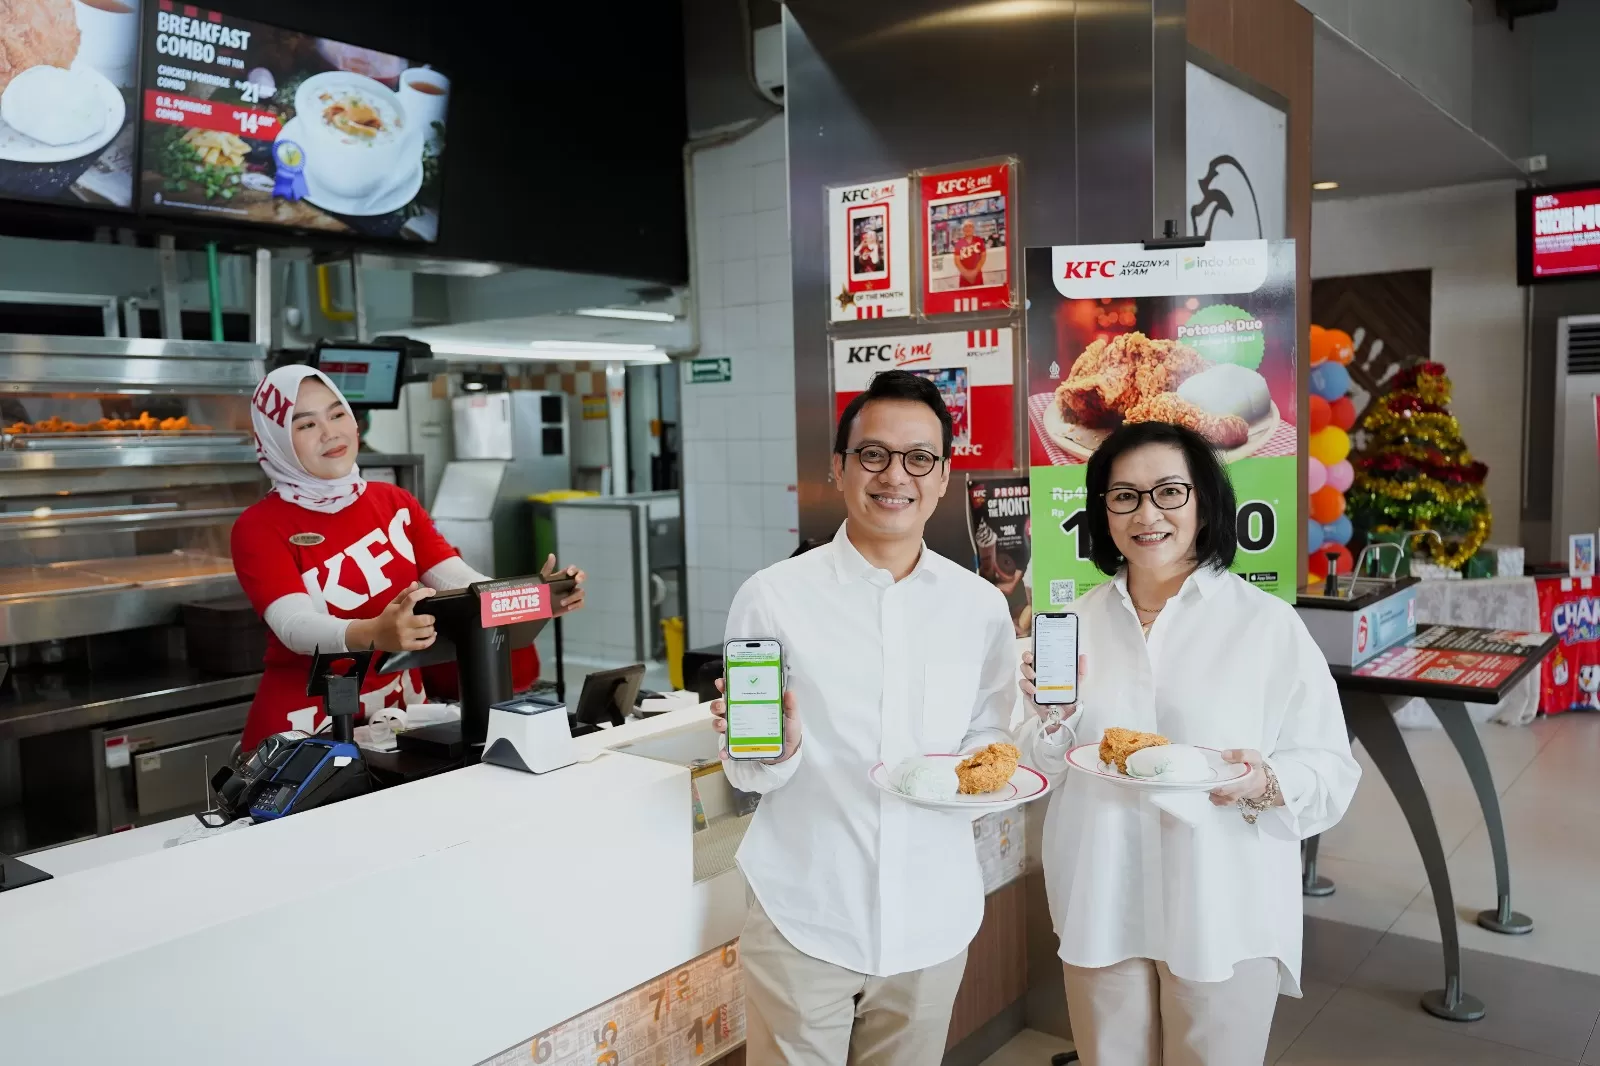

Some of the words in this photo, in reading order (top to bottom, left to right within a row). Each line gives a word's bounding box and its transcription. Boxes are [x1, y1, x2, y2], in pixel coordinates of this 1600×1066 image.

[157, 11, 251, 51] BREAKFAST
[156, 34, 216, 64] COMBO
[936, 178, 966, 194] KFC
[841, 188, 869, 203] KFC
[960, 242, 981, 260] KFC
[1064, 260, 1116, 279] KFC
[1122, 260, 1170, 268] JAGONYA
[1119, 268, 1149, 276] AYAM
[879, 291, 904, 299] MONTH
[1236, 319, 1263, 331] Duo
[847, 345, 892, 363] KFC
[894, 343, 905, 361] is
[252, 376, 295, 428] KF
[953, 444, 983, 456] KFC
[973, 489, 987, 498] KFC
[994, 486, 1028, 498] PROMO
[998, 497, 1030, 517] MONT
[1051, 508, 1065, 519] Rp
[301, 508, 416, 616] KFC
[491, 589, 521, 599] PESANAN
[521, 586, 540, 595] ANDA
[491, 594, 540, 613] GRATIS
[648, 988, 667, 1022] 7
[687, 1006, 722, 1056] 11
[531, 1033, 552, 1065] 6
